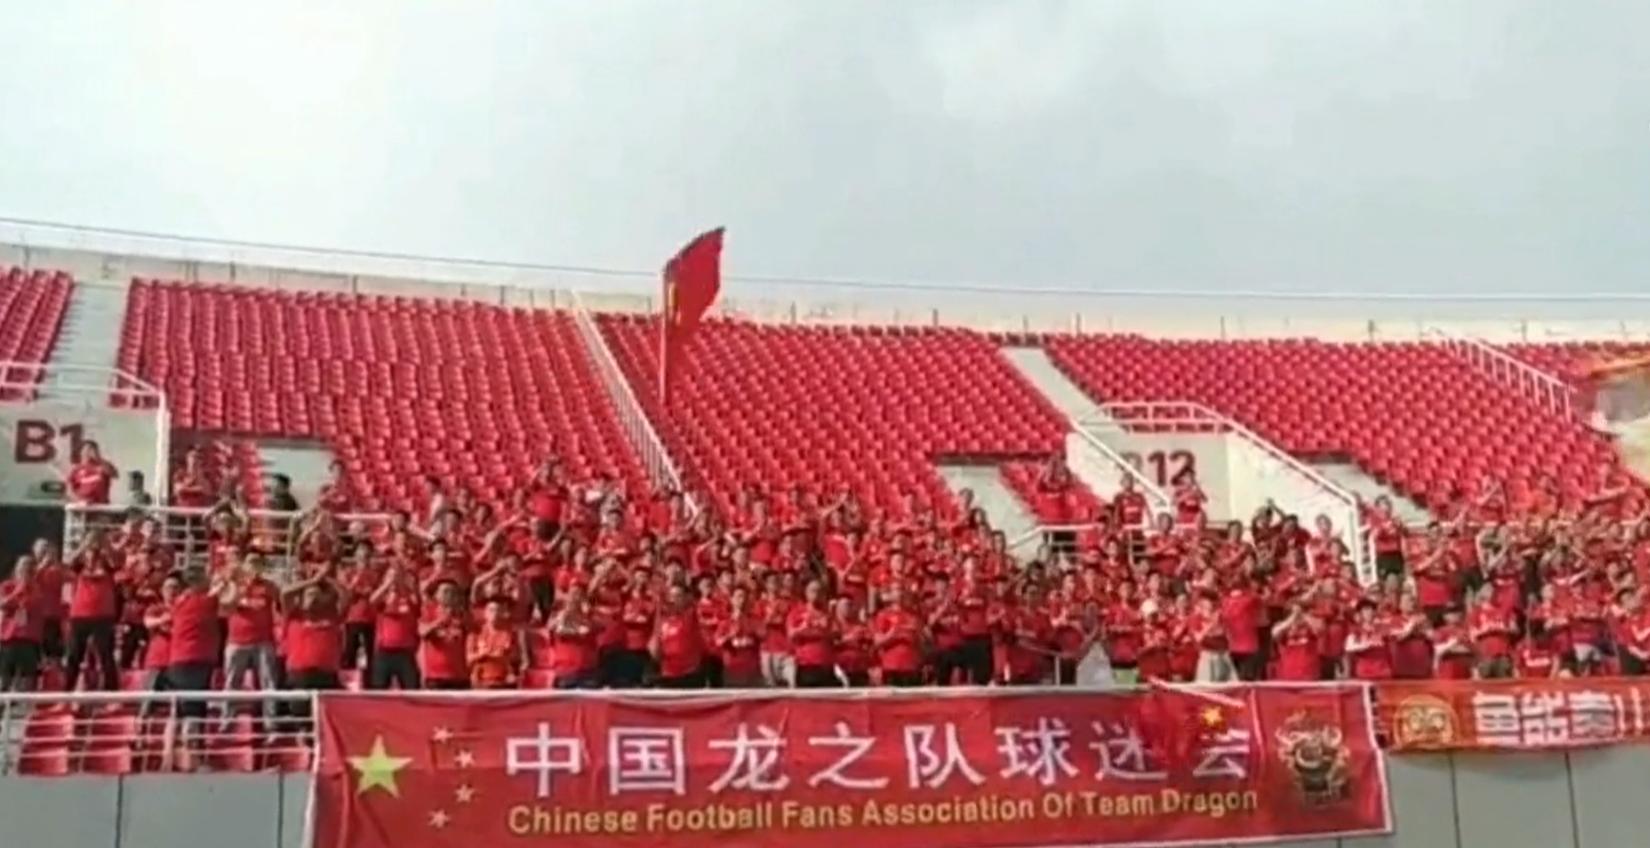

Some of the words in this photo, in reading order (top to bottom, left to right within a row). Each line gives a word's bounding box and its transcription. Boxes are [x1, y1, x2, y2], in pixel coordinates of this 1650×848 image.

[15, 420, 83, 463] B1
[505, 717, 1251, 798] 中国龙之队球迷会
[508, 804, 637, 834] Chinese
[646, 801, 773, 832] Football
[781, 799, 852, 829] Fans
[861, 794, 1035, 826] Association
[1042, 792, 1073, 818] Of
[1079, 790, 1155, 817] Team
[1160, 788, 1259, 818] Dragon
